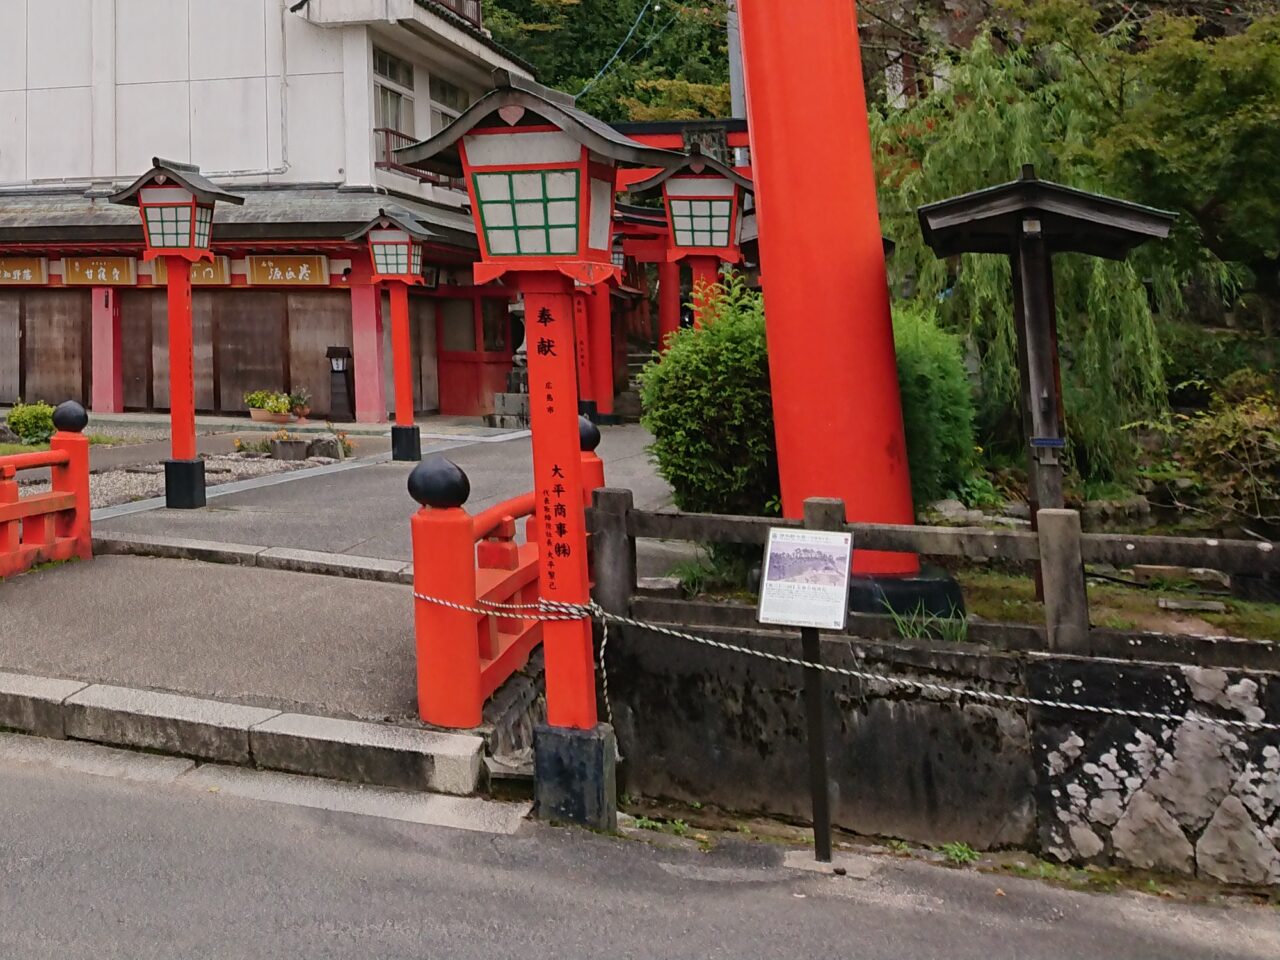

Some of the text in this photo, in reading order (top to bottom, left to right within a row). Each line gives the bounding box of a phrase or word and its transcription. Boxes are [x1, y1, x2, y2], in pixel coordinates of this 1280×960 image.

[537, 306, 557, 357] 奉献
[545, 381, 554, 414] 広島市
